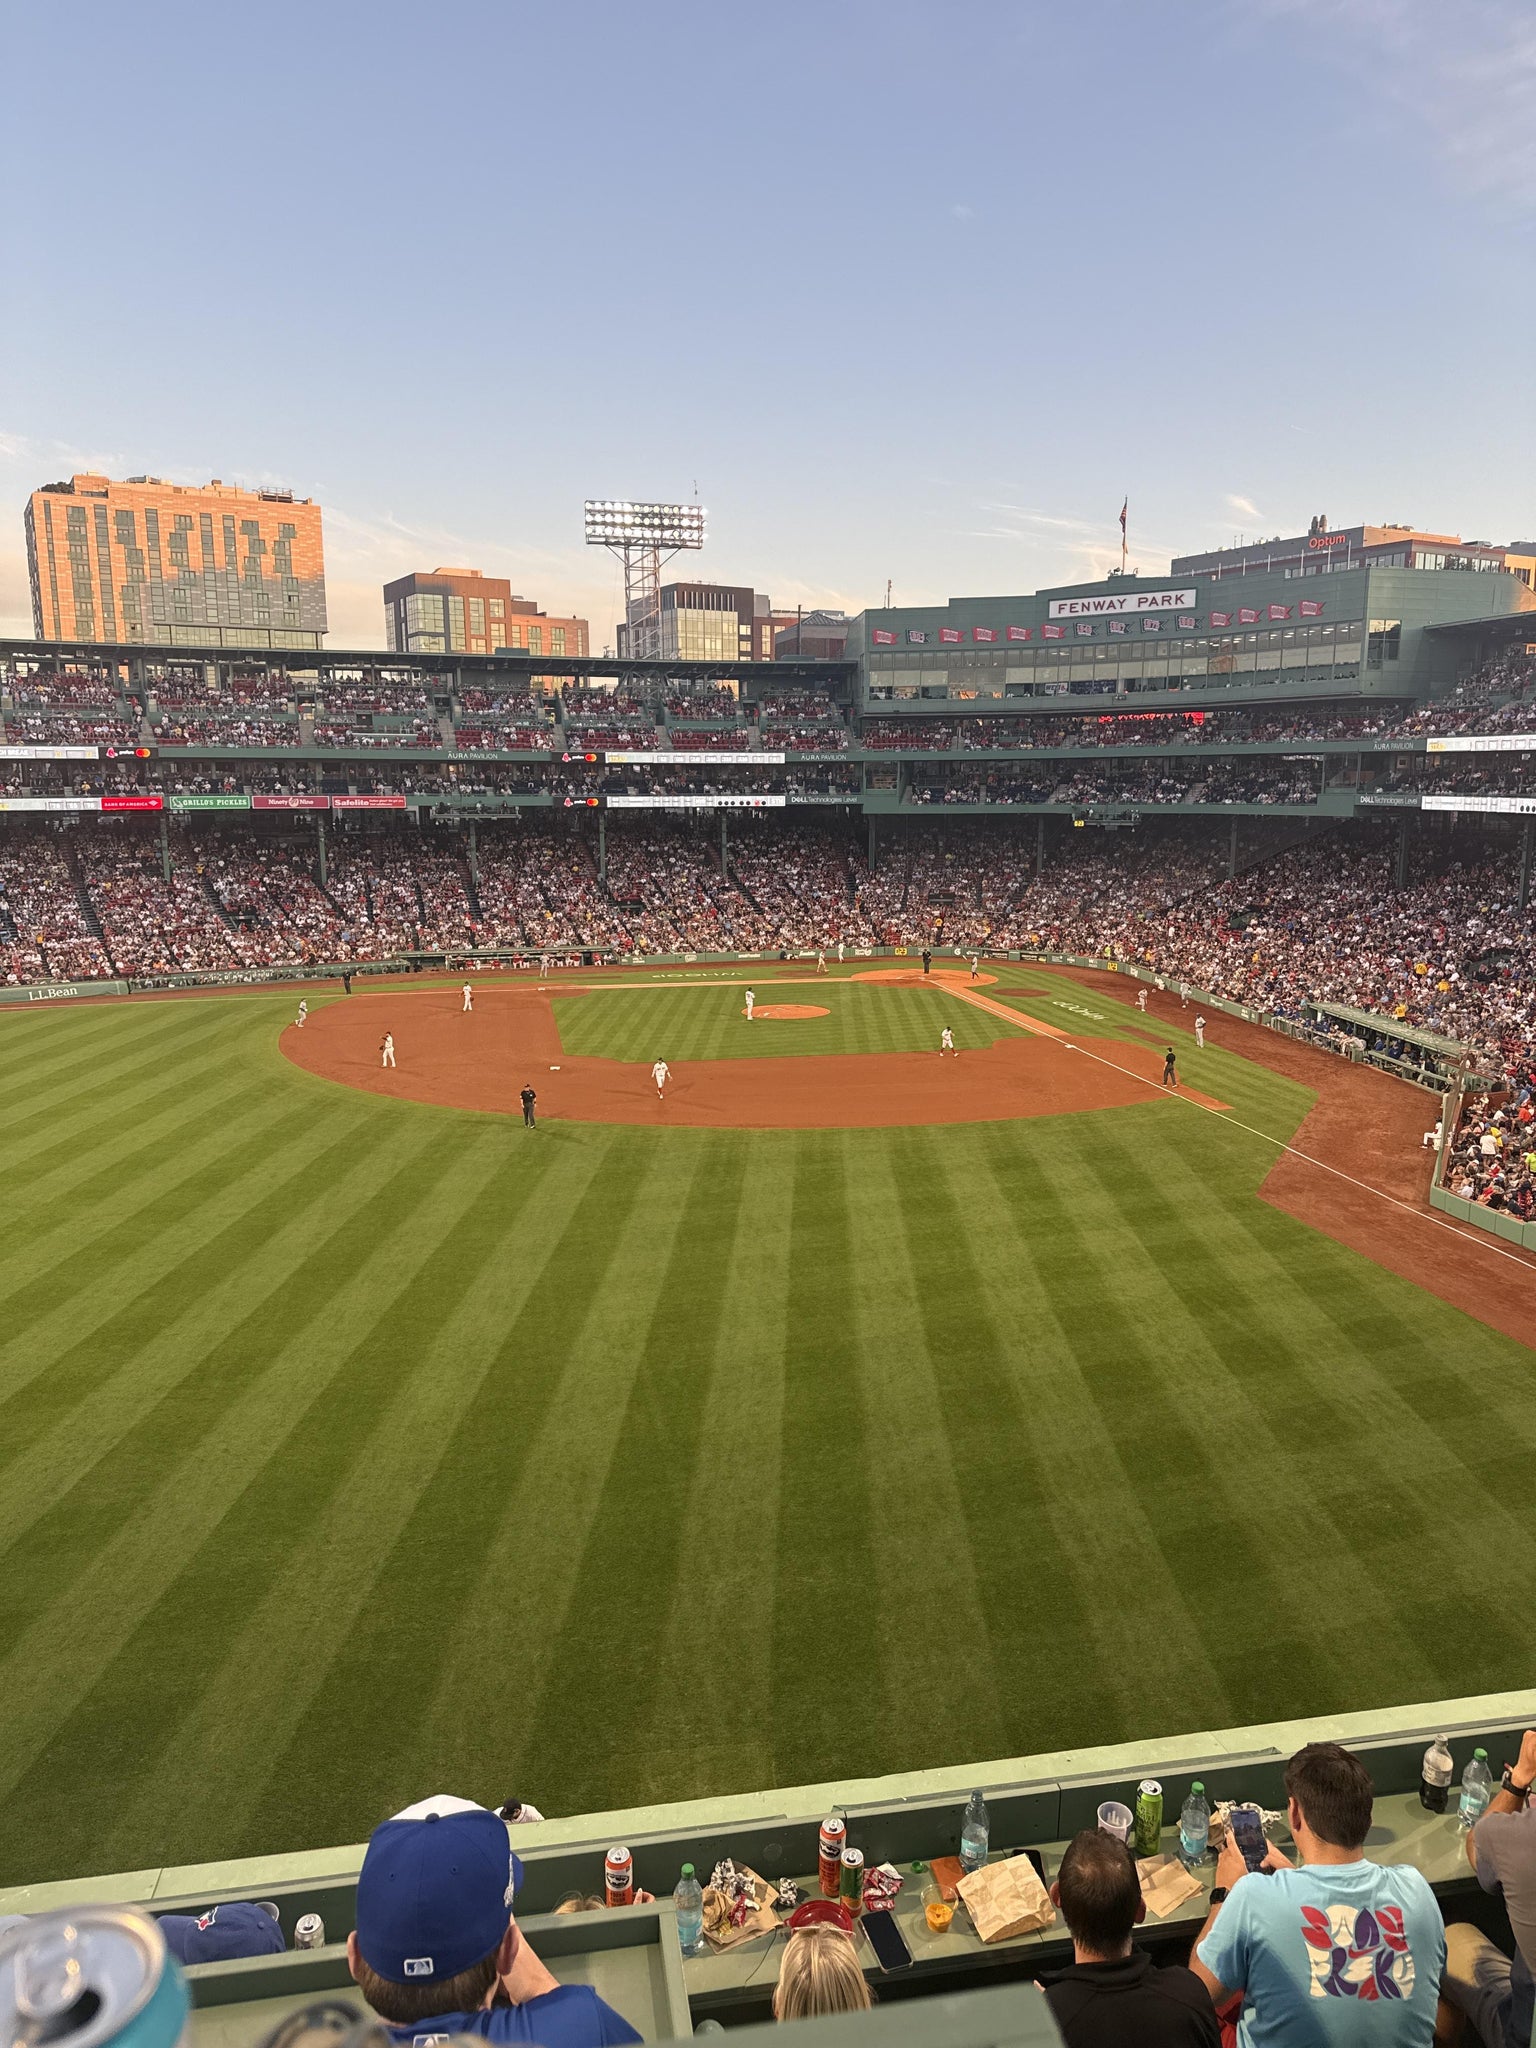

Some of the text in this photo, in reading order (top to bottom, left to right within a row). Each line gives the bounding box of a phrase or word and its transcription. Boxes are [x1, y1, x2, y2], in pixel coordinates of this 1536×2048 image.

[1308, 534, 1346, 549] Optum
[1057, 593, 1185, 614] FENWAY PARK
[182, 798, 248, 806] GRILLO'S PICKLES
[808, 796, 842, 804] Technologies
[1360, 796, 1418, 805] DELL Technologies Level
[28, 985, 78, 1001] L.L.Bean
